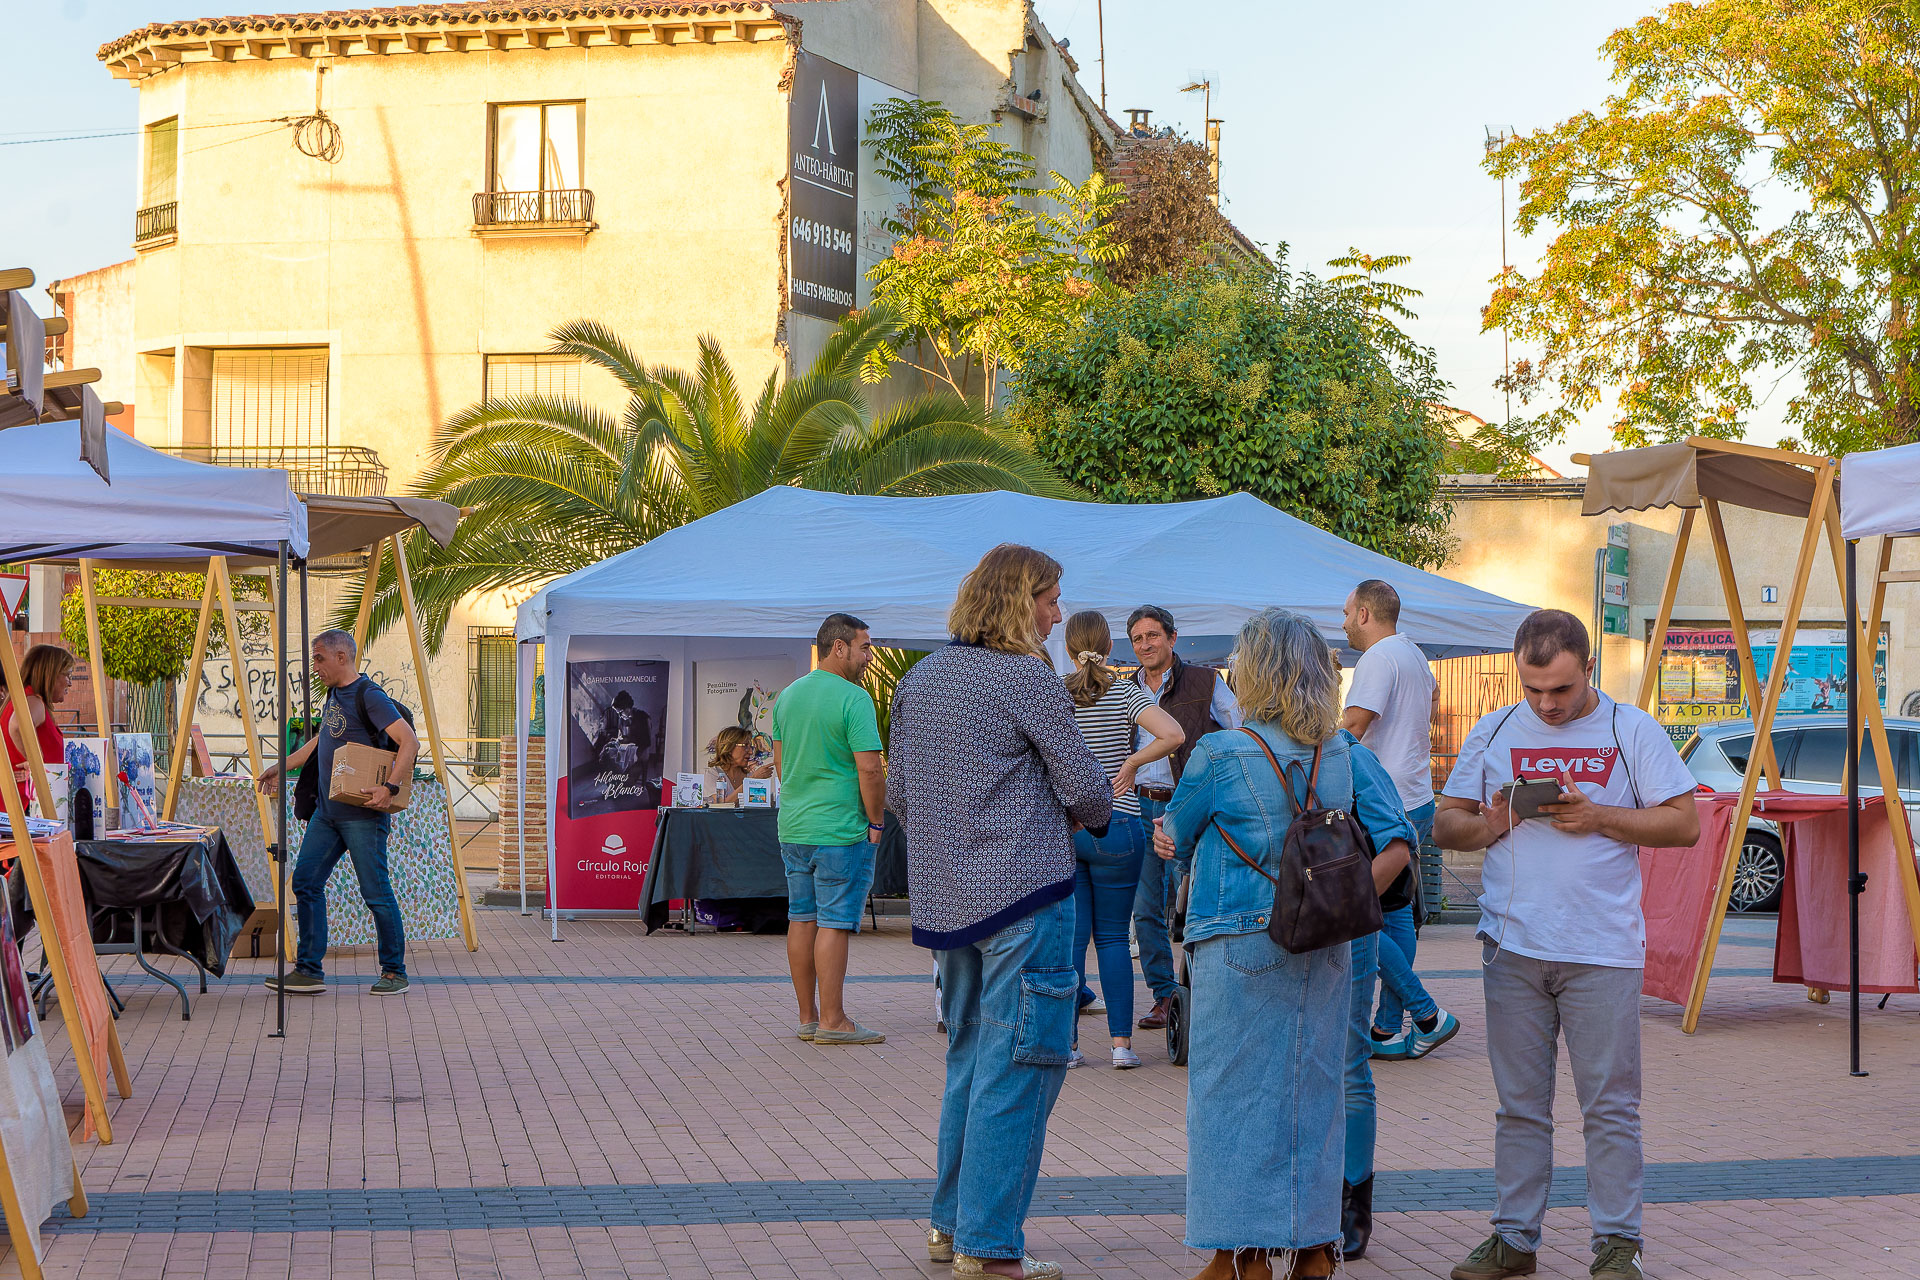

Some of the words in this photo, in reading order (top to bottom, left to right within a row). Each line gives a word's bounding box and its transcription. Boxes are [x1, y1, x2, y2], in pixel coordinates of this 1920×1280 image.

[793, 151, 855, 189] ANTEO-HÁBITAT
[792, 215, 811, 243] 646
[813, 221, 831, 249] 913
[833, 228, 852, 255] 546
[791, 277, 818, 299] HALETS
[818, 284, 853, 308] PAREADOS
[1765, 587, 1772, 602] 1
[1664, 634, 1736, 645] NDY&LUCA
[587, 676, 614, 685] CARMEN
[614, 675, 657, 683] MANZANEQUE
[707, 681, 737, 689] Penúltimo
[1658, 705, 1741, 716] MADRID
[593, 770, 629, 787] Hilvanes
[601, 782, 644, 801] Blancos
[577, 859, 620, 872] Círculo
